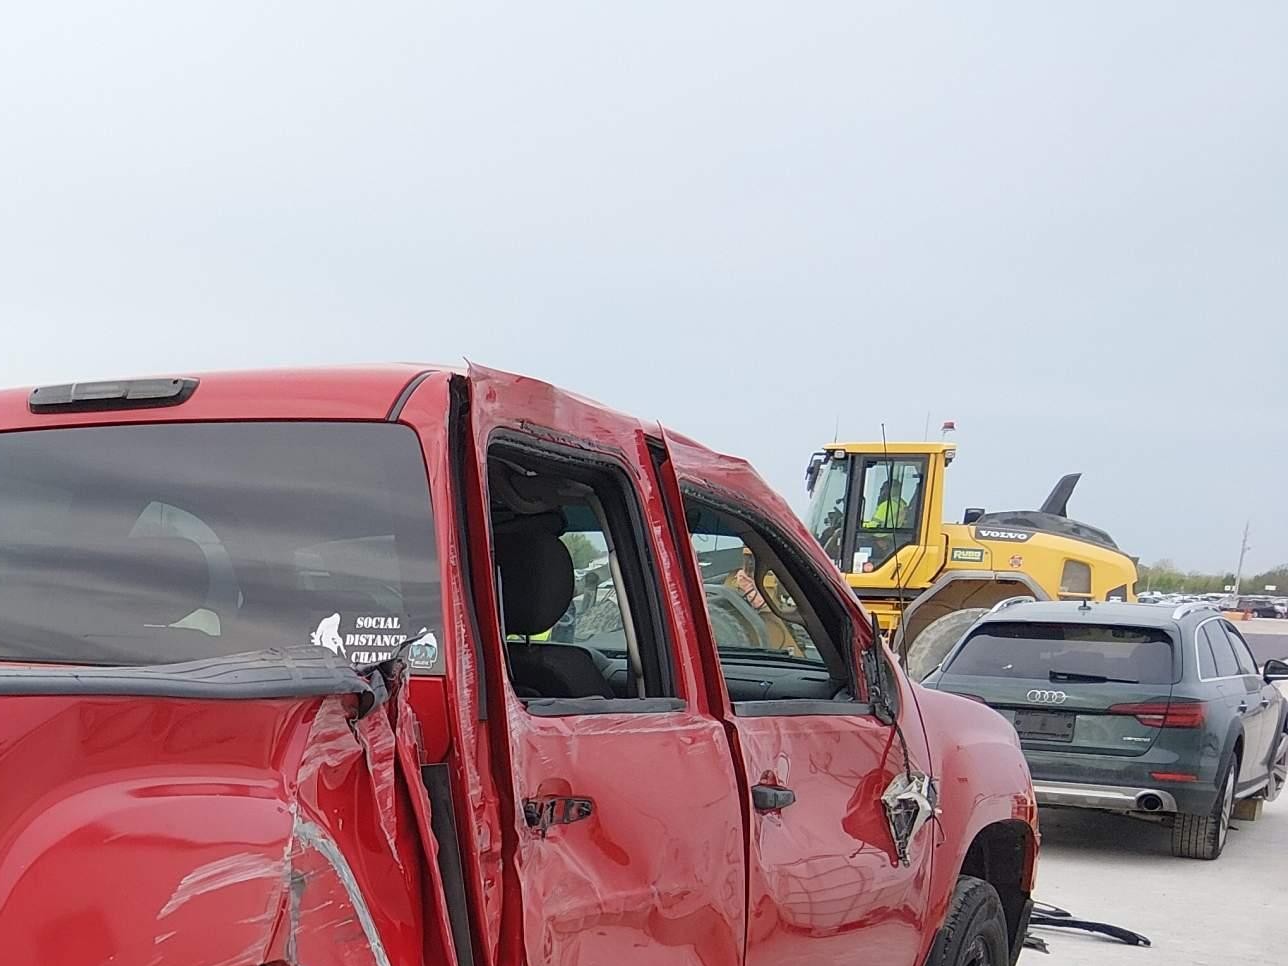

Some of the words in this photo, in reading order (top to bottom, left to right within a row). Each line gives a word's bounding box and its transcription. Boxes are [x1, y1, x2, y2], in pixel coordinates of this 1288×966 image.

[979, 530, 1028, 540] VOLVO
[355, 616, 401, 629] SOCIAL
[345, 634, 408, 647] DISTANCE
